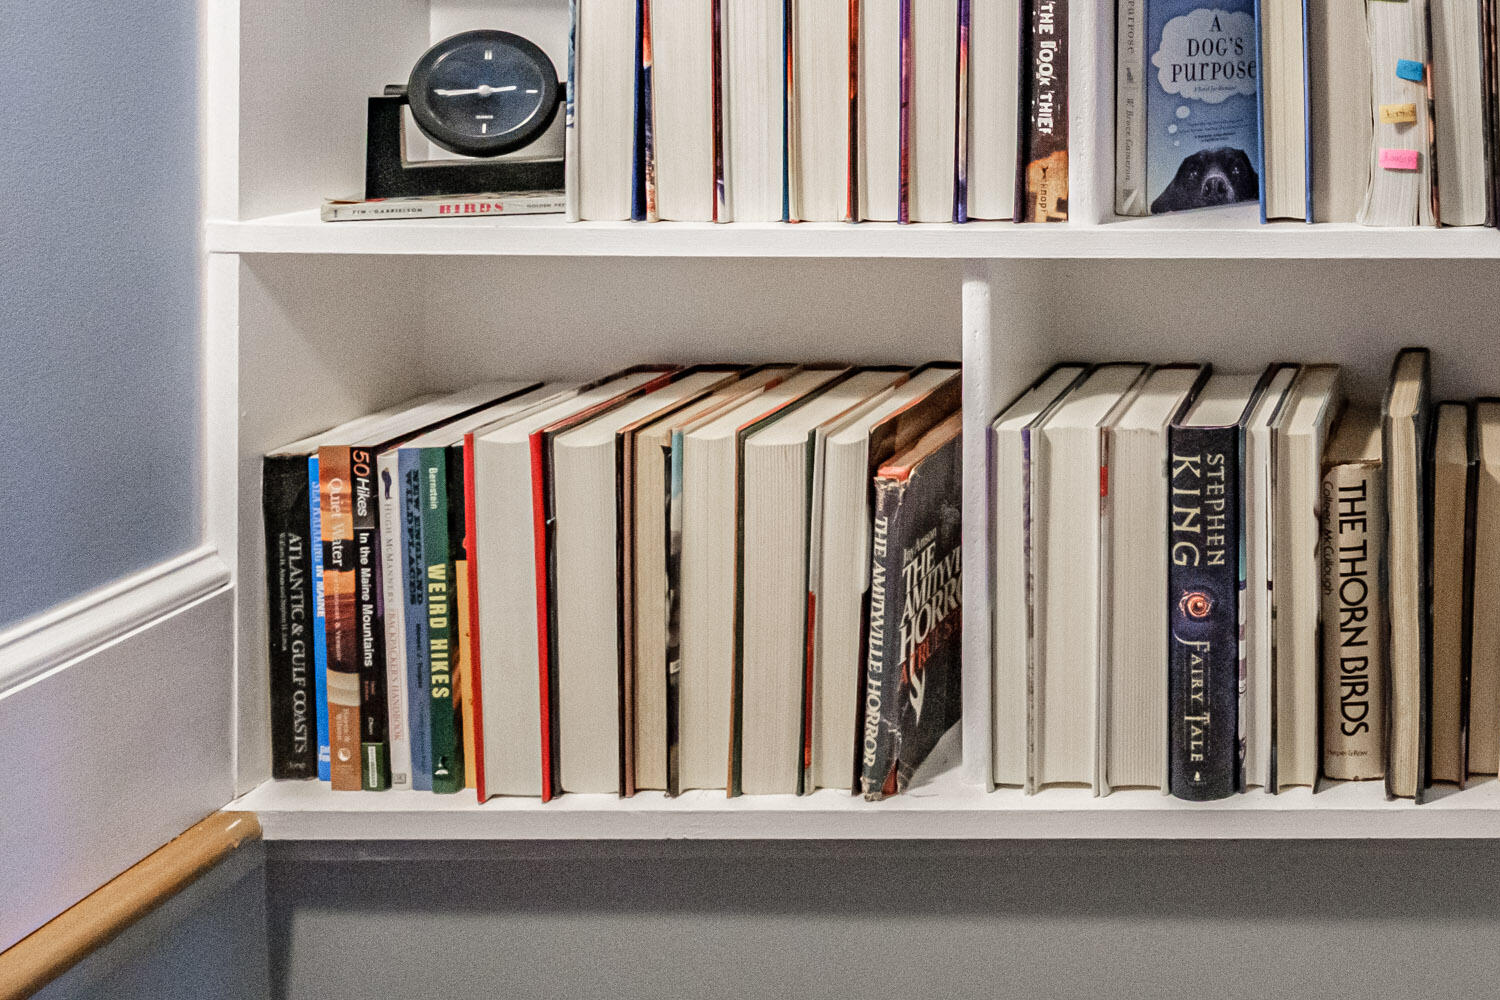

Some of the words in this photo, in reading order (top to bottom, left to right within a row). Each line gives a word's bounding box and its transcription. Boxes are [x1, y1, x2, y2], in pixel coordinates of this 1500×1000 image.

[1038, 3, 1054, 34] THE
[1210, 15, 1222, 31] A
[1187, 38, 1243, 57] DOG'S
[1038, 92, 1054, 134] THIEF
[439, 203, 503, 214] BIRDS
[353, 450, 369, 476] 50
[328, 477, 343, 518] Quiet
[355, 477, 369, 516] Hikes
[413, 470, 421, 507] NEW
[429, 468, 439, 509] Bernstein
[1172, 454, 1201, 566] KING
[1206, 454, 1225, 566] STEPHEN
[1323, 481, 1334, 525] Colleen
[1339, 480, 1367, 533] THE
[331, 524, 345, 566] Water
[359, 533, 370, 543] In
[360, 546, 371, 564] the
[414, 511, 424, 605] ENGLAND
[874, 517, 888, 557] THE
[287, 534, 304, 619] ATLANTIC
[315, 565, 324, 577] IN
[1323, 529, 1334, 595] McCullough
[316, 581, 325, 617] MAINE
[361, 568, 372, 602] Maine
[427, 564, 446, 628] WEIRD
[1339, 540, 1368, 646] THORN
[291, 622, 302, 635] &
[362, 605, 374, 666] Mountains
[867, 560, 887, 673] AMITYVILLE
[291, 640, 306, 686] GULF
[429, 640, 449, 699] HIKES
[1173, 632, 1210, 704] FAIRY
[1339, 658, 1368, 737] BIRDS
[293, 691, 307, 752] COASTS
[863, 680, 883, 767] HORROR
[1183, 713, 1210, 761] TALE
